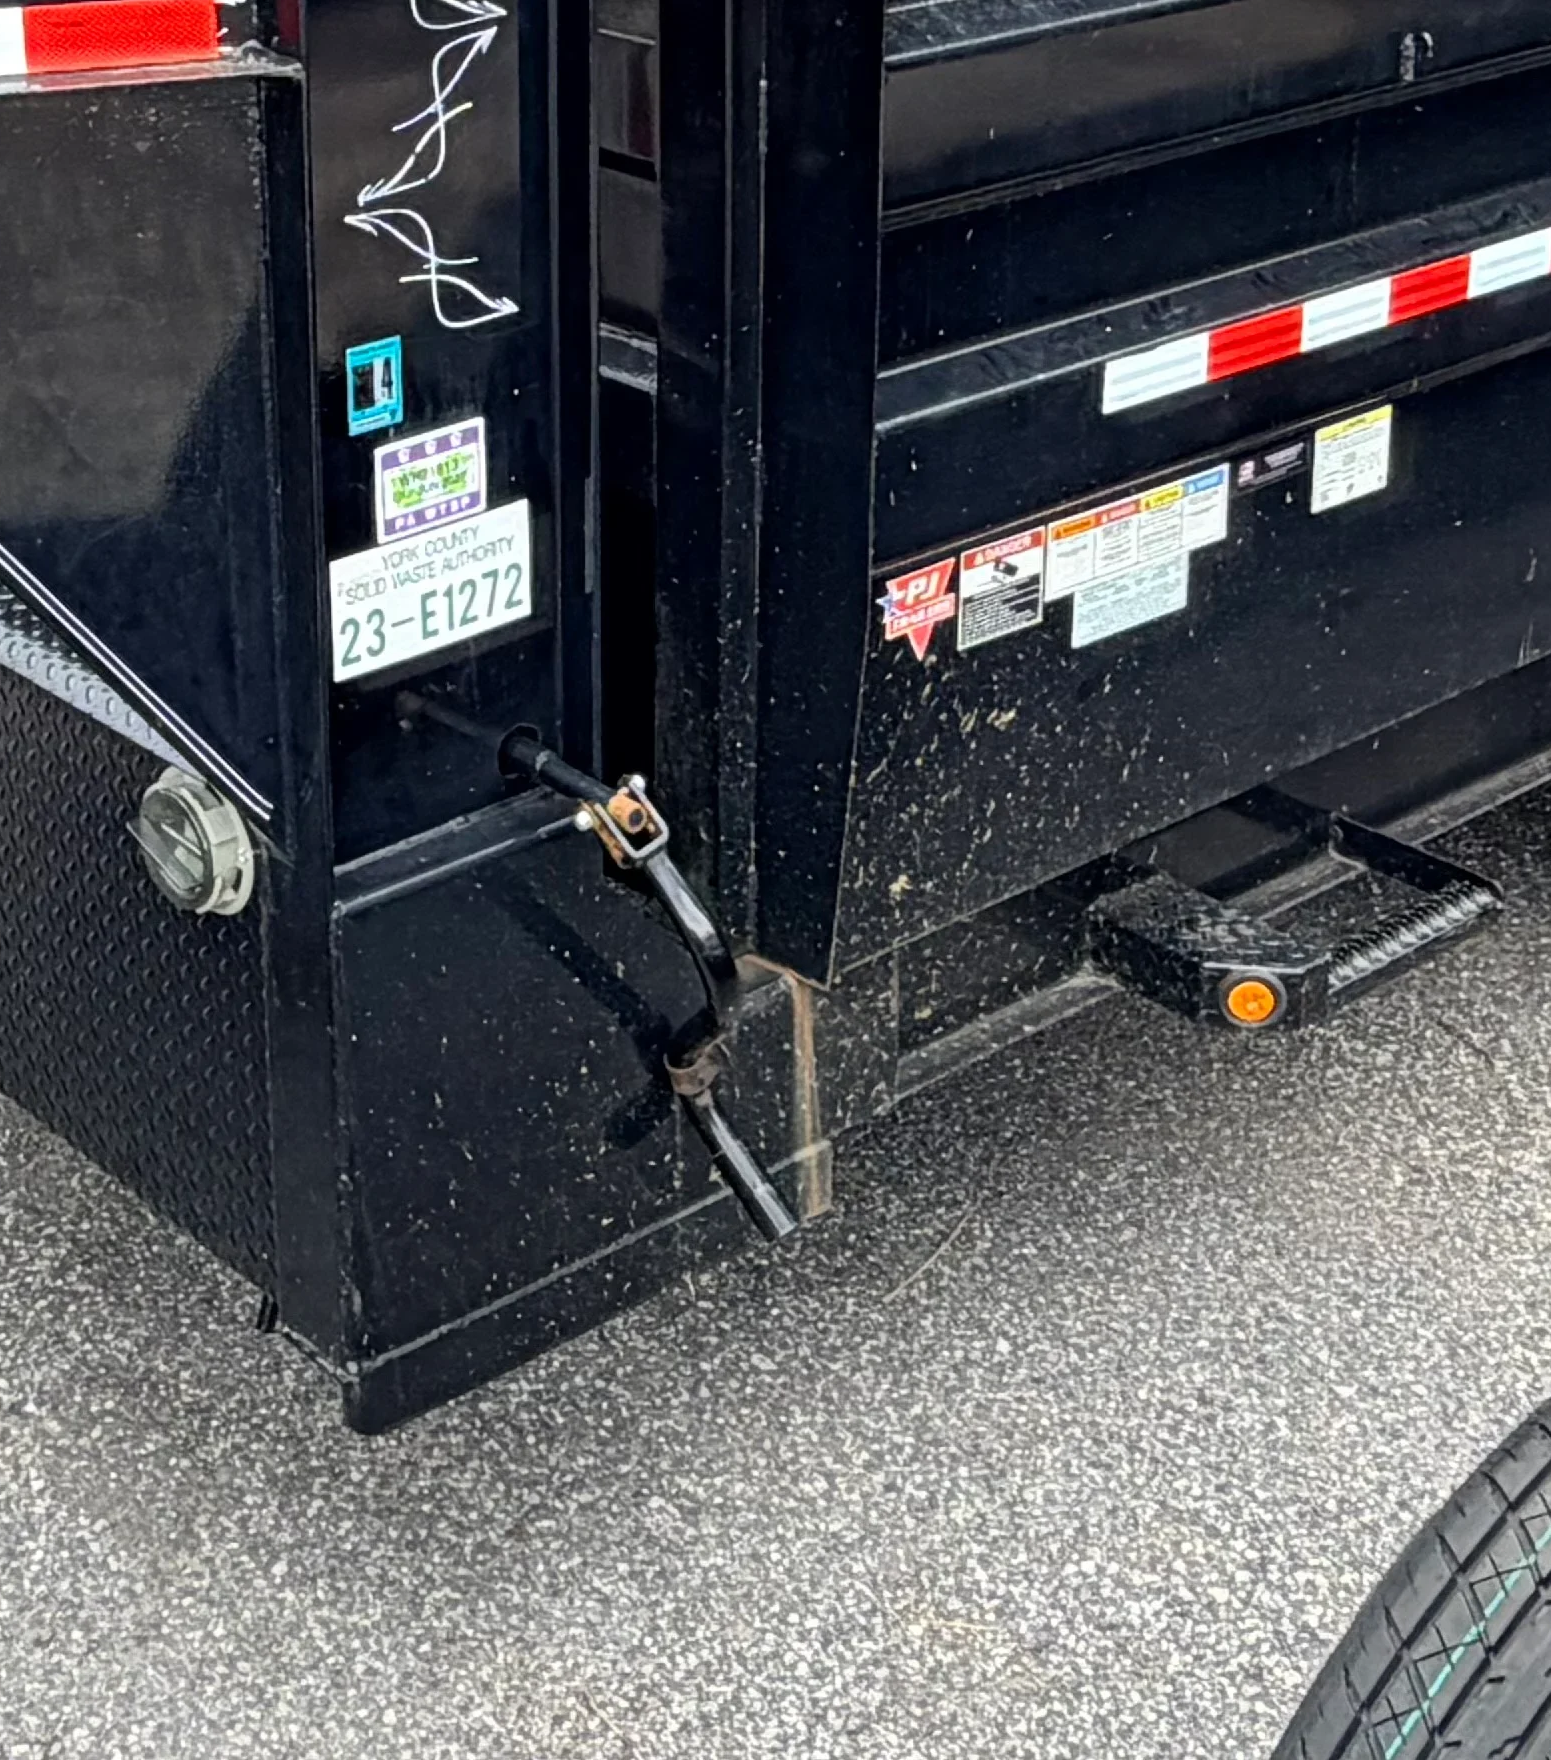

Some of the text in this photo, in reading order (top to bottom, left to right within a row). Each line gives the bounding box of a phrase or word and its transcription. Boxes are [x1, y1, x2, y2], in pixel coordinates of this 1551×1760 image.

[345, 534, 515, 606] SOLID WASTE AUTHORITY
[381, 524, 480, 571] YORK COUNTY
[339, 562, 524, 668] 23-E1272
[905, 570, 941, 605] PJ
